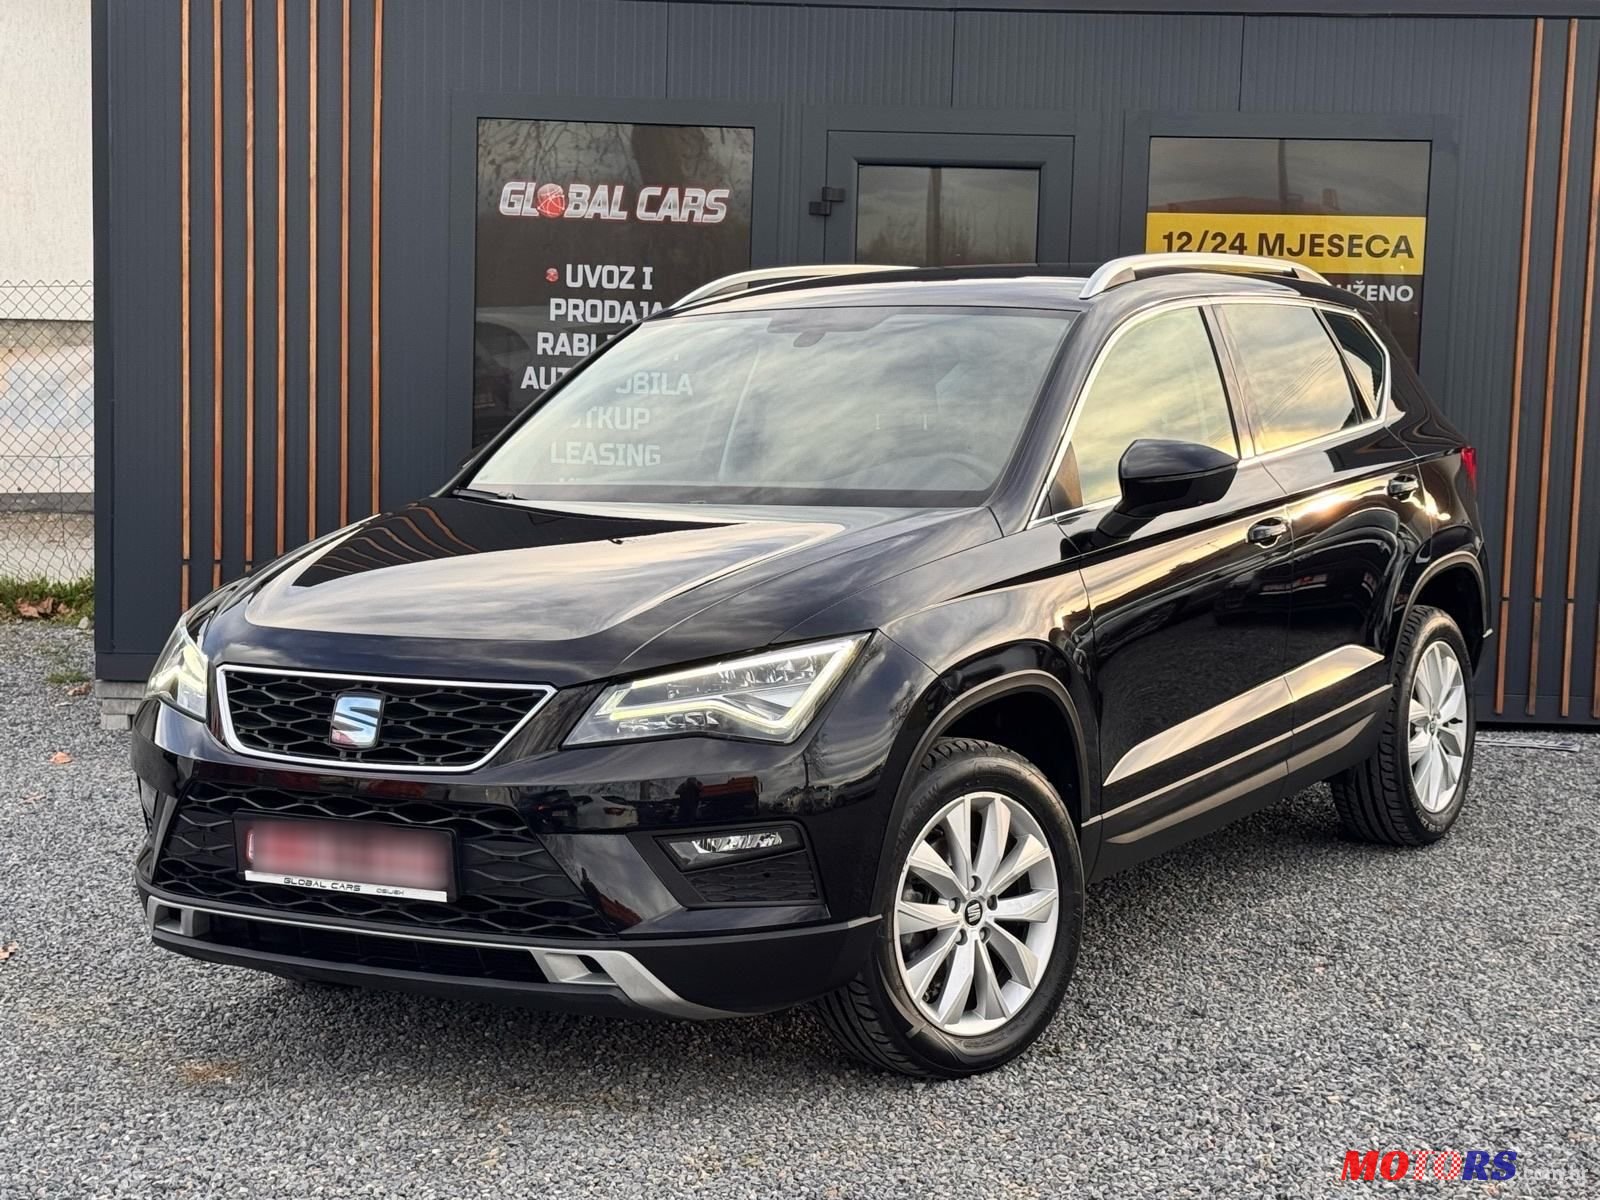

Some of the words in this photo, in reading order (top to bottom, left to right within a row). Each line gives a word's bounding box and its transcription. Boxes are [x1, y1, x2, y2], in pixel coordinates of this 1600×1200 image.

[499, 181, 628, 221] GLOBAL
[636, 187, 730, 223] CARS
[1162, 230, 1248, 254] 12/24
[1257, 233, 1414, 259] MJESECA
[565, 263, 635, 290] UVOZ
[642, 266, 653, 290] I
[570, 406, 650, 430] TKUP
[551, 441, 661, 467] LEASING
[283, 877, 327, 888] GLOBAL
[330, 882, 361, 892] CARS
